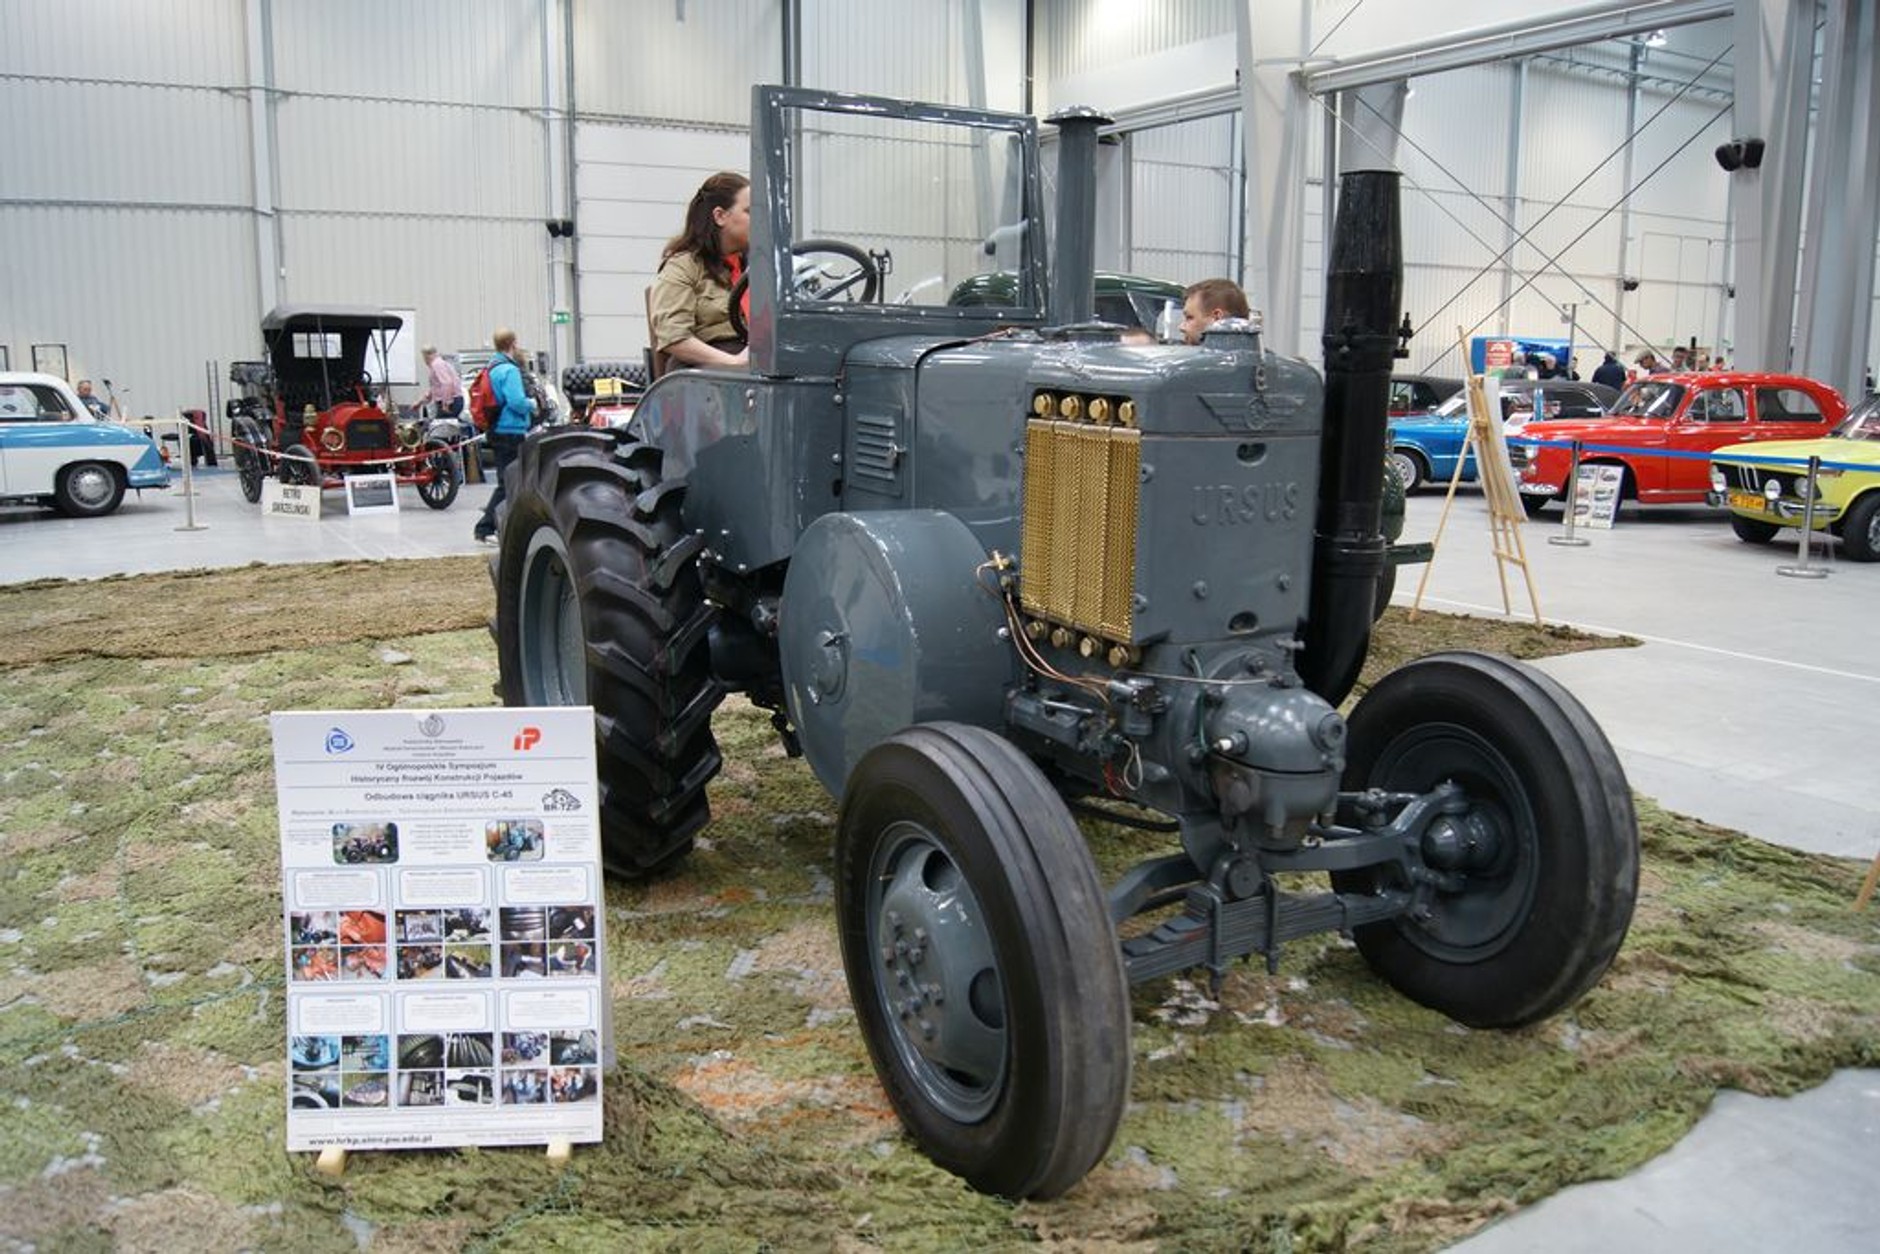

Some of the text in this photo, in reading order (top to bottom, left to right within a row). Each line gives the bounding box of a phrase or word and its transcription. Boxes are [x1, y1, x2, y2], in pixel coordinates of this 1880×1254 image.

[1192, 482, 1299, 526] URSUS
[434, 772, 482, 783] Konstrukcji
[364, 791, 414, 801] Odbudowa
[456, 790, 490, 800] URSUS
[491, 790, 514, 799] C-45
